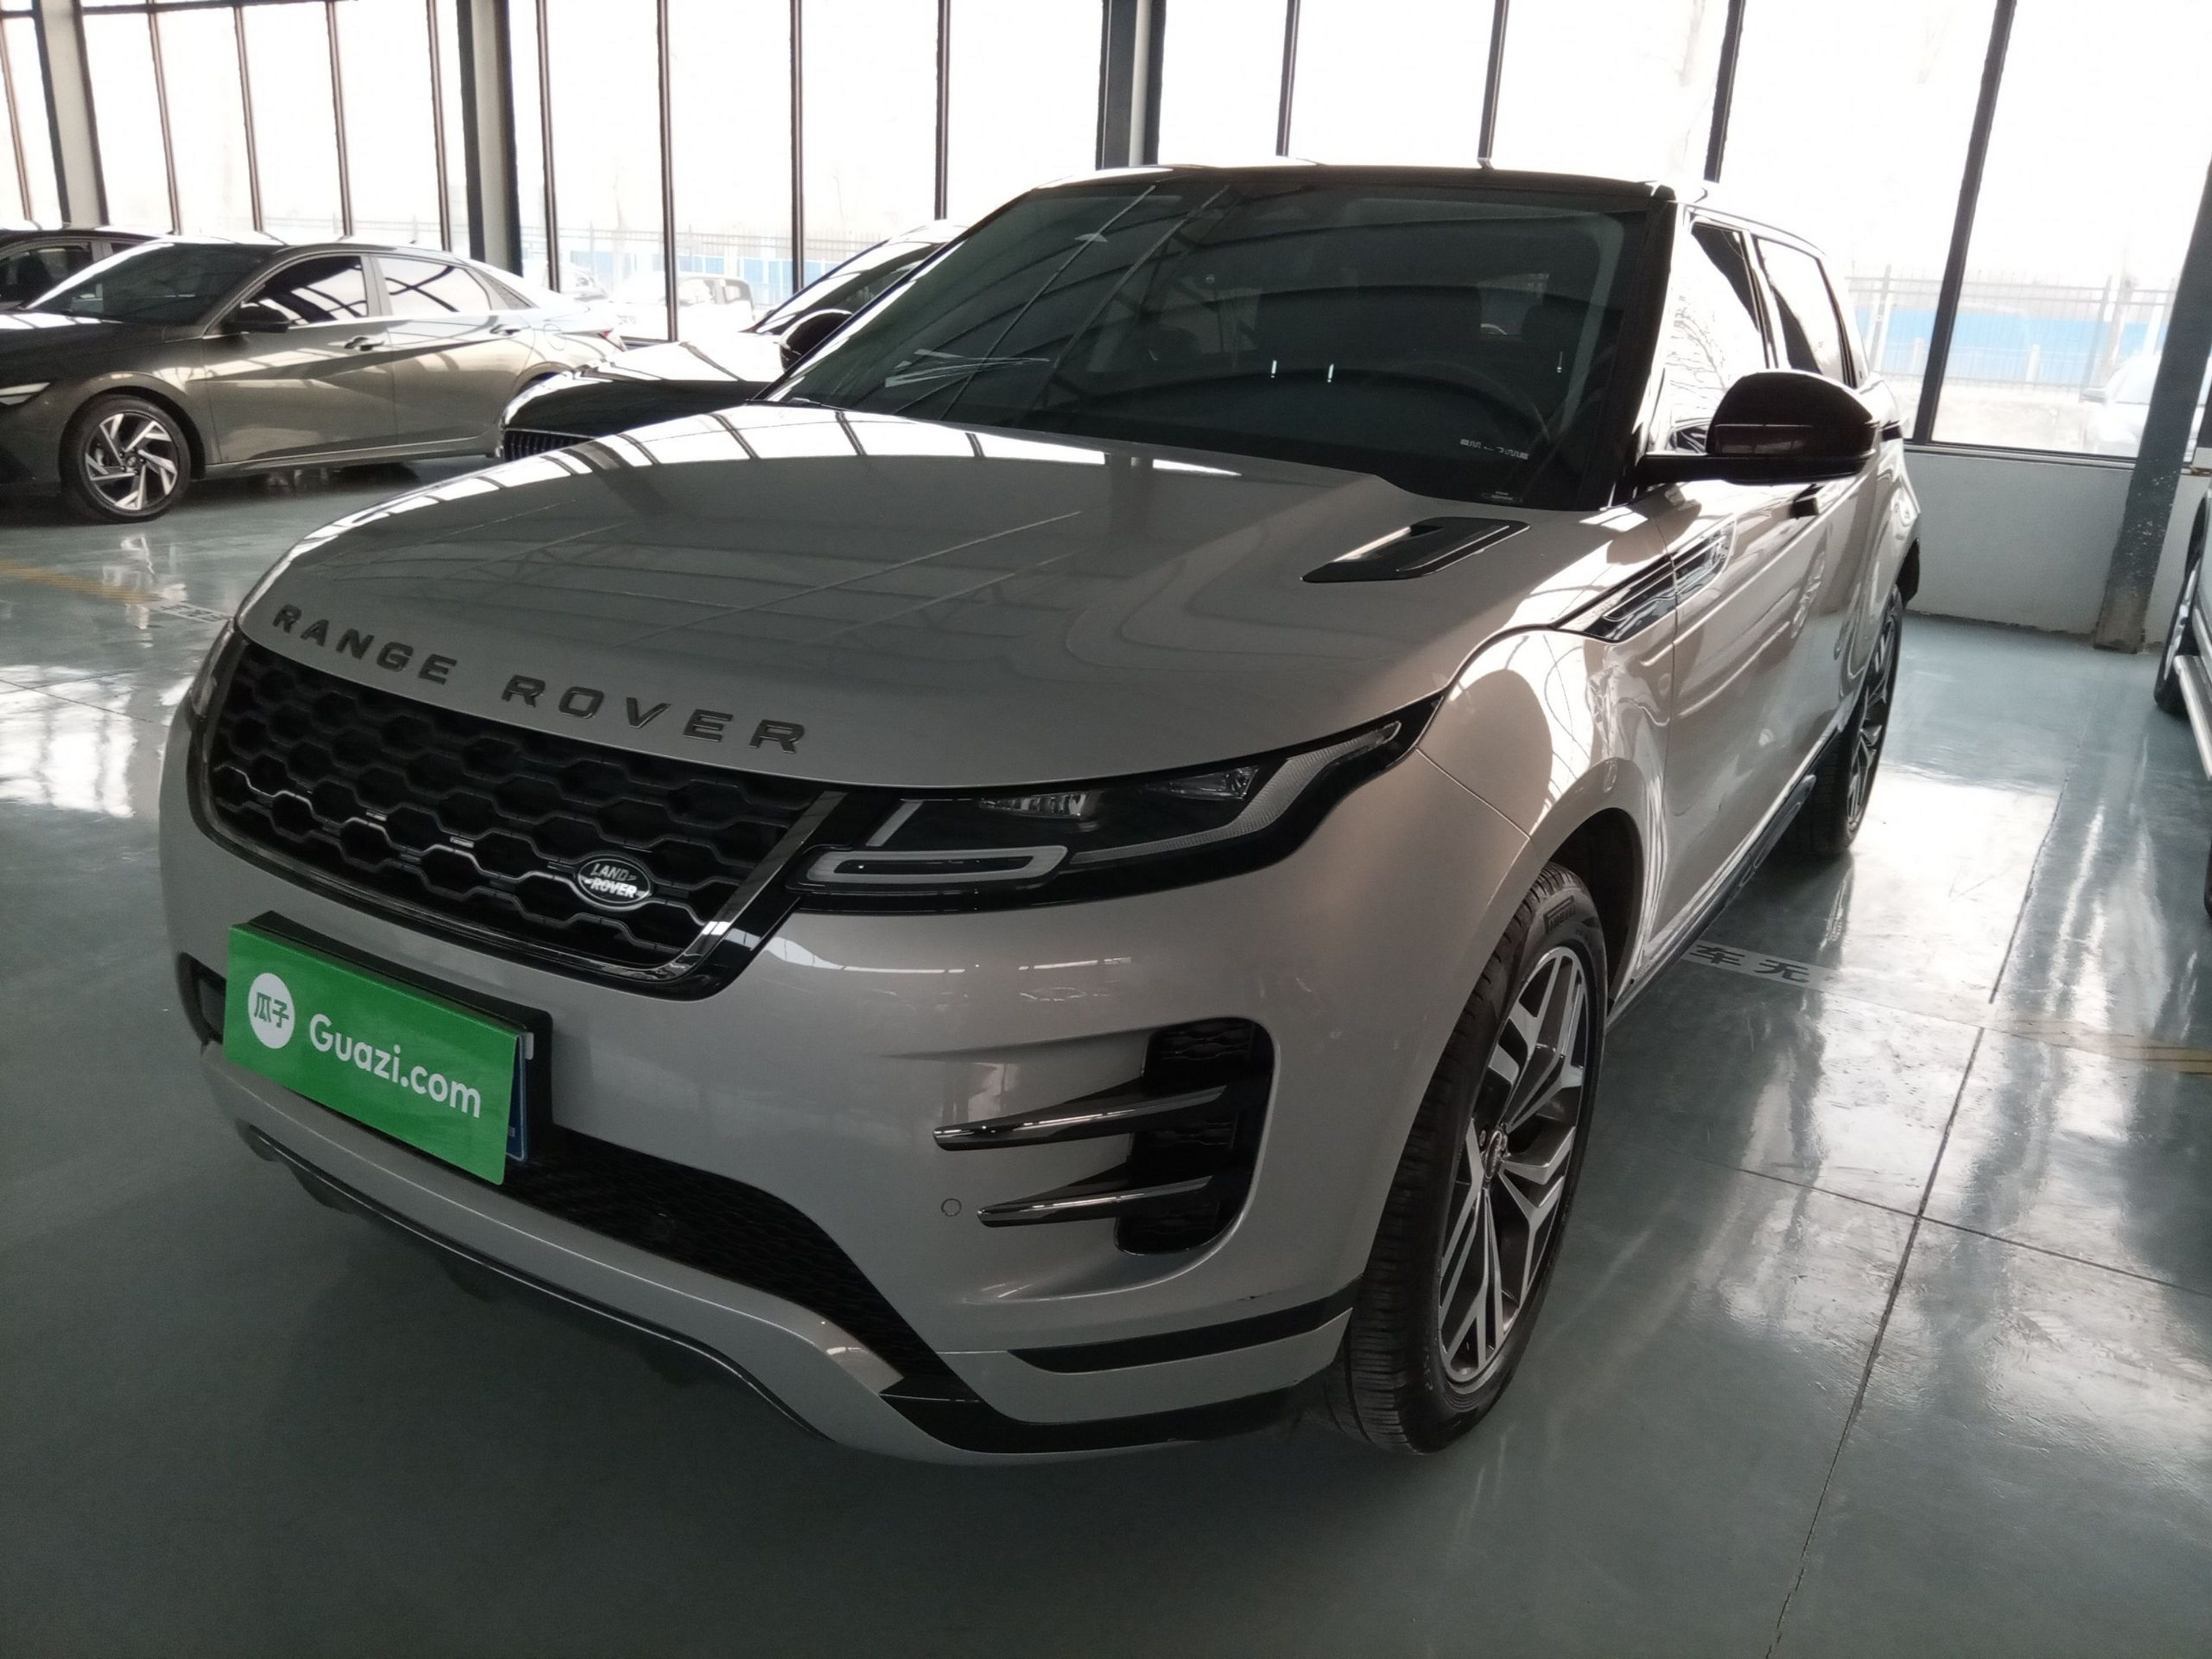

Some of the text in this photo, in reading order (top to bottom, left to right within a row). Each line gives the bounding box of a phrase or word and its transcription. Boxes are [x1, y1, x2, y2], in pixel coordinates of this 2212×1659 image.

[272, 604, 805, 753] RANGE ROVER
[590, 863, 630, 881] LAND
[590, 877, 638, 898] ROVER
[253, 992, 289, 1028] 瓜子
[310, 1014, 480, 1118] Guazi.com
